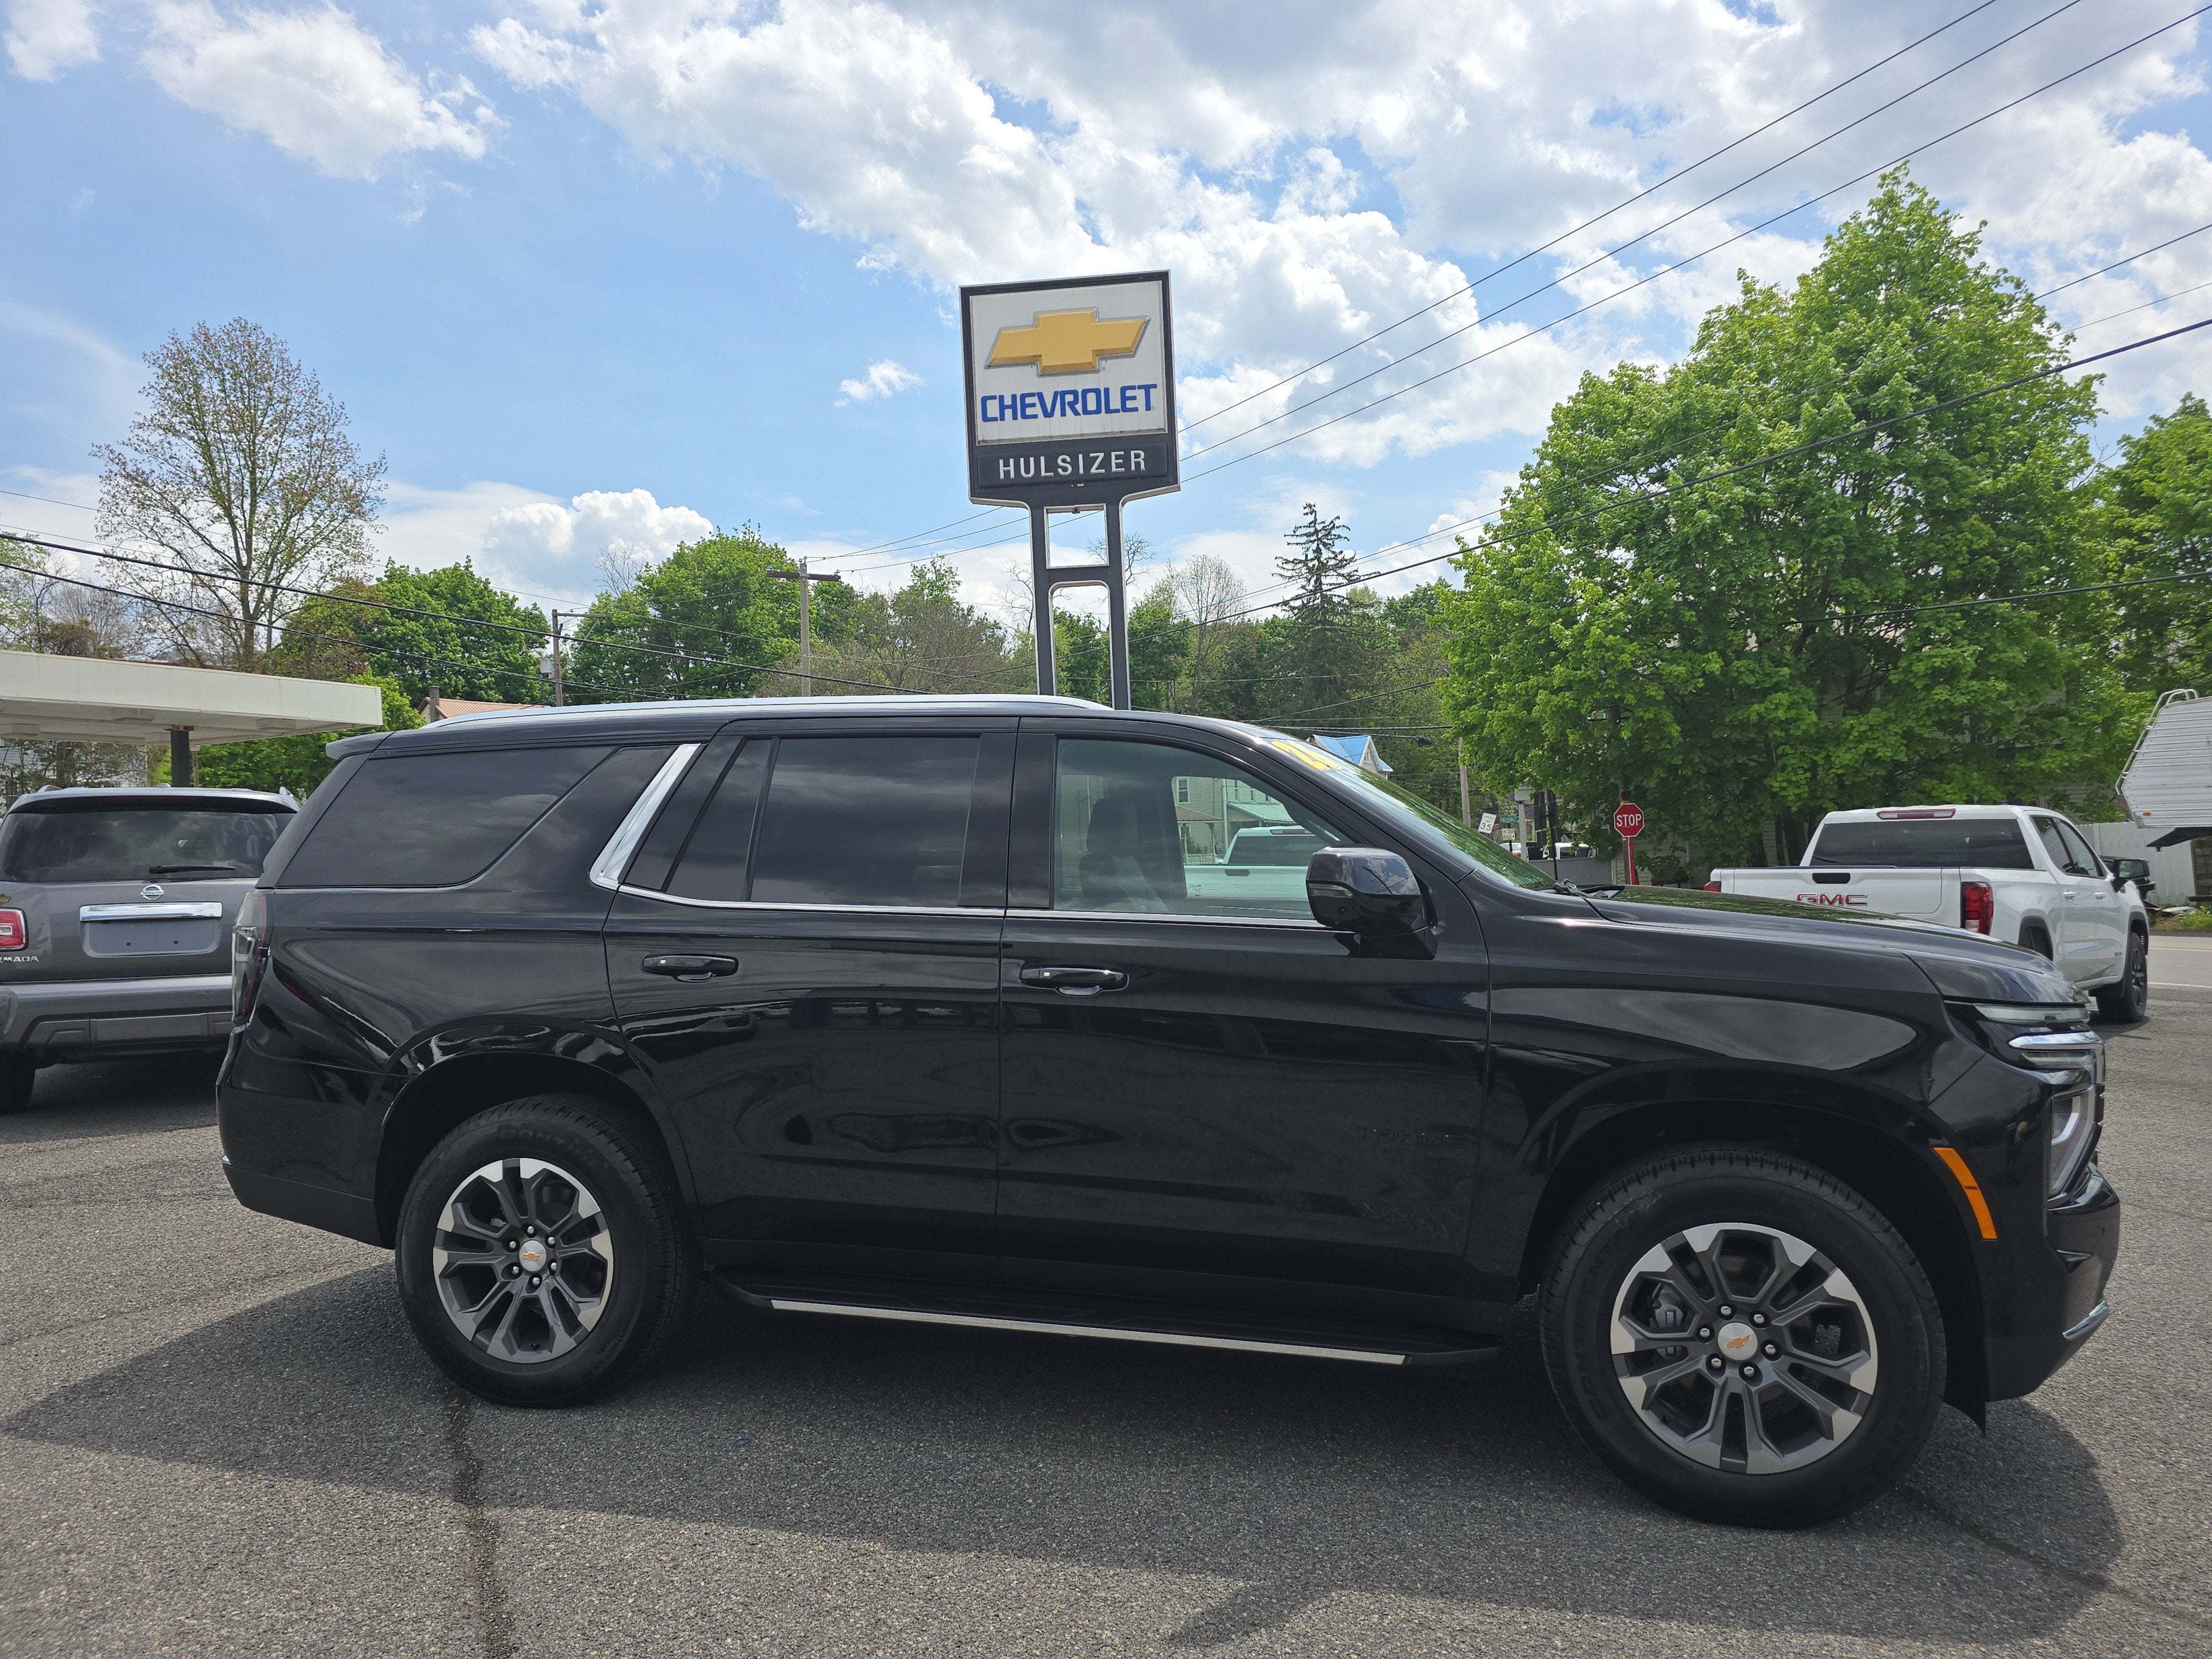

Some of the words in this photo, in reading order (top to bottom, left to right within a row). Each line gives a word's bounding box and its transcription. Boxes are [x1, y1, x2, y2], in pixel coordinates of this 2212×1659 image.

[981, 383, 1158, 422] CHEVROLET
[999, 450, 1146, 480] HULSIZER
[1481, 822, 1492, 831] 35
[1616, 814, 1642, 827] STOP
[1797, 893, 1868, 906] GMC
